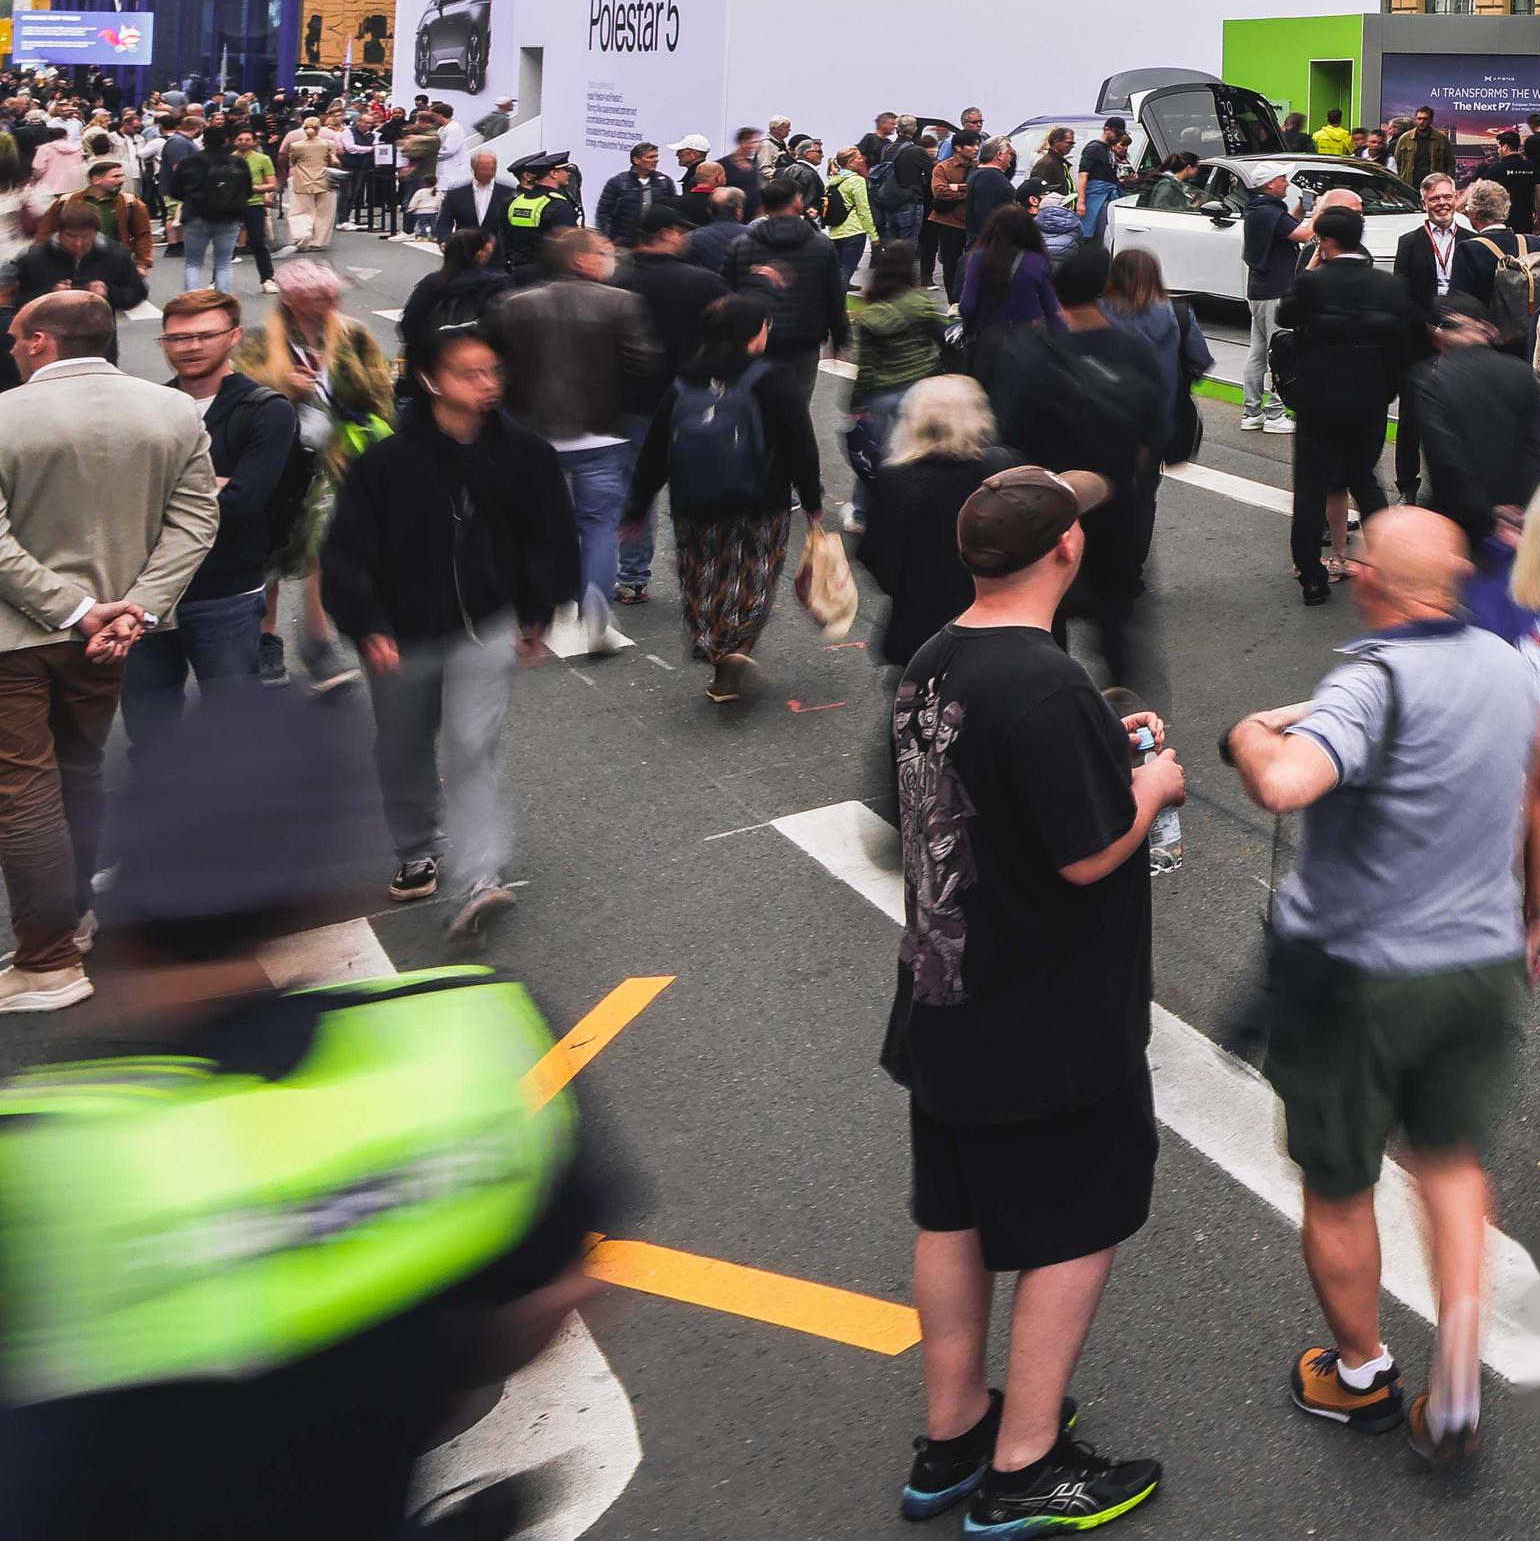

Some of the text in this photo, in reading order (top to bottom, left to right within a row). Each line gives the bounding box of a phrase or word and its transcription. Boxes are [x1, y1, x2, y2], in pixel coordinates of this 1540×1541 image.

[1430, 88, 1440, 98] AI
[1442, 87, 1509, 99] TRANSFORMS
[1511, 88, 1530, 99] THE
[1453, 101, 1472, 111] The
[1473, 101, 1497, 111] Next
[1498, 101, 1511, 112] P7
